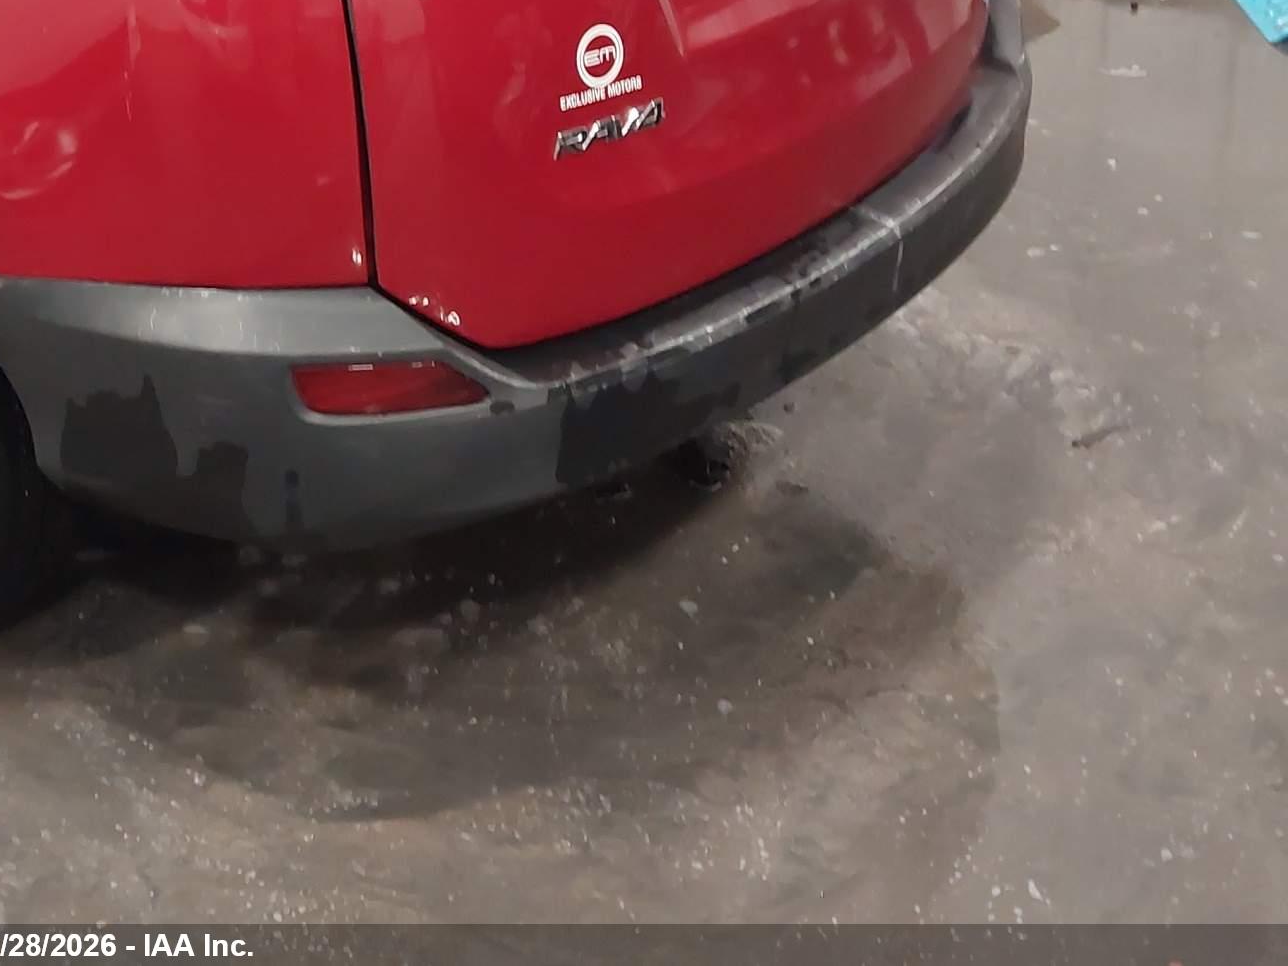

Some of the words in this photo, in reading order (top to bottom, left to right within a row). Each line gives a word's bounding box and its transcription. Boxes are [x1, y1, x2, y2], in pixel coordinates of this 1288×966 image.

[559, 87, 606, 112] EXCLUSIVE
[607, 75, 643, 99] MOTORS
[553, 97, 665, 161] RAV4
